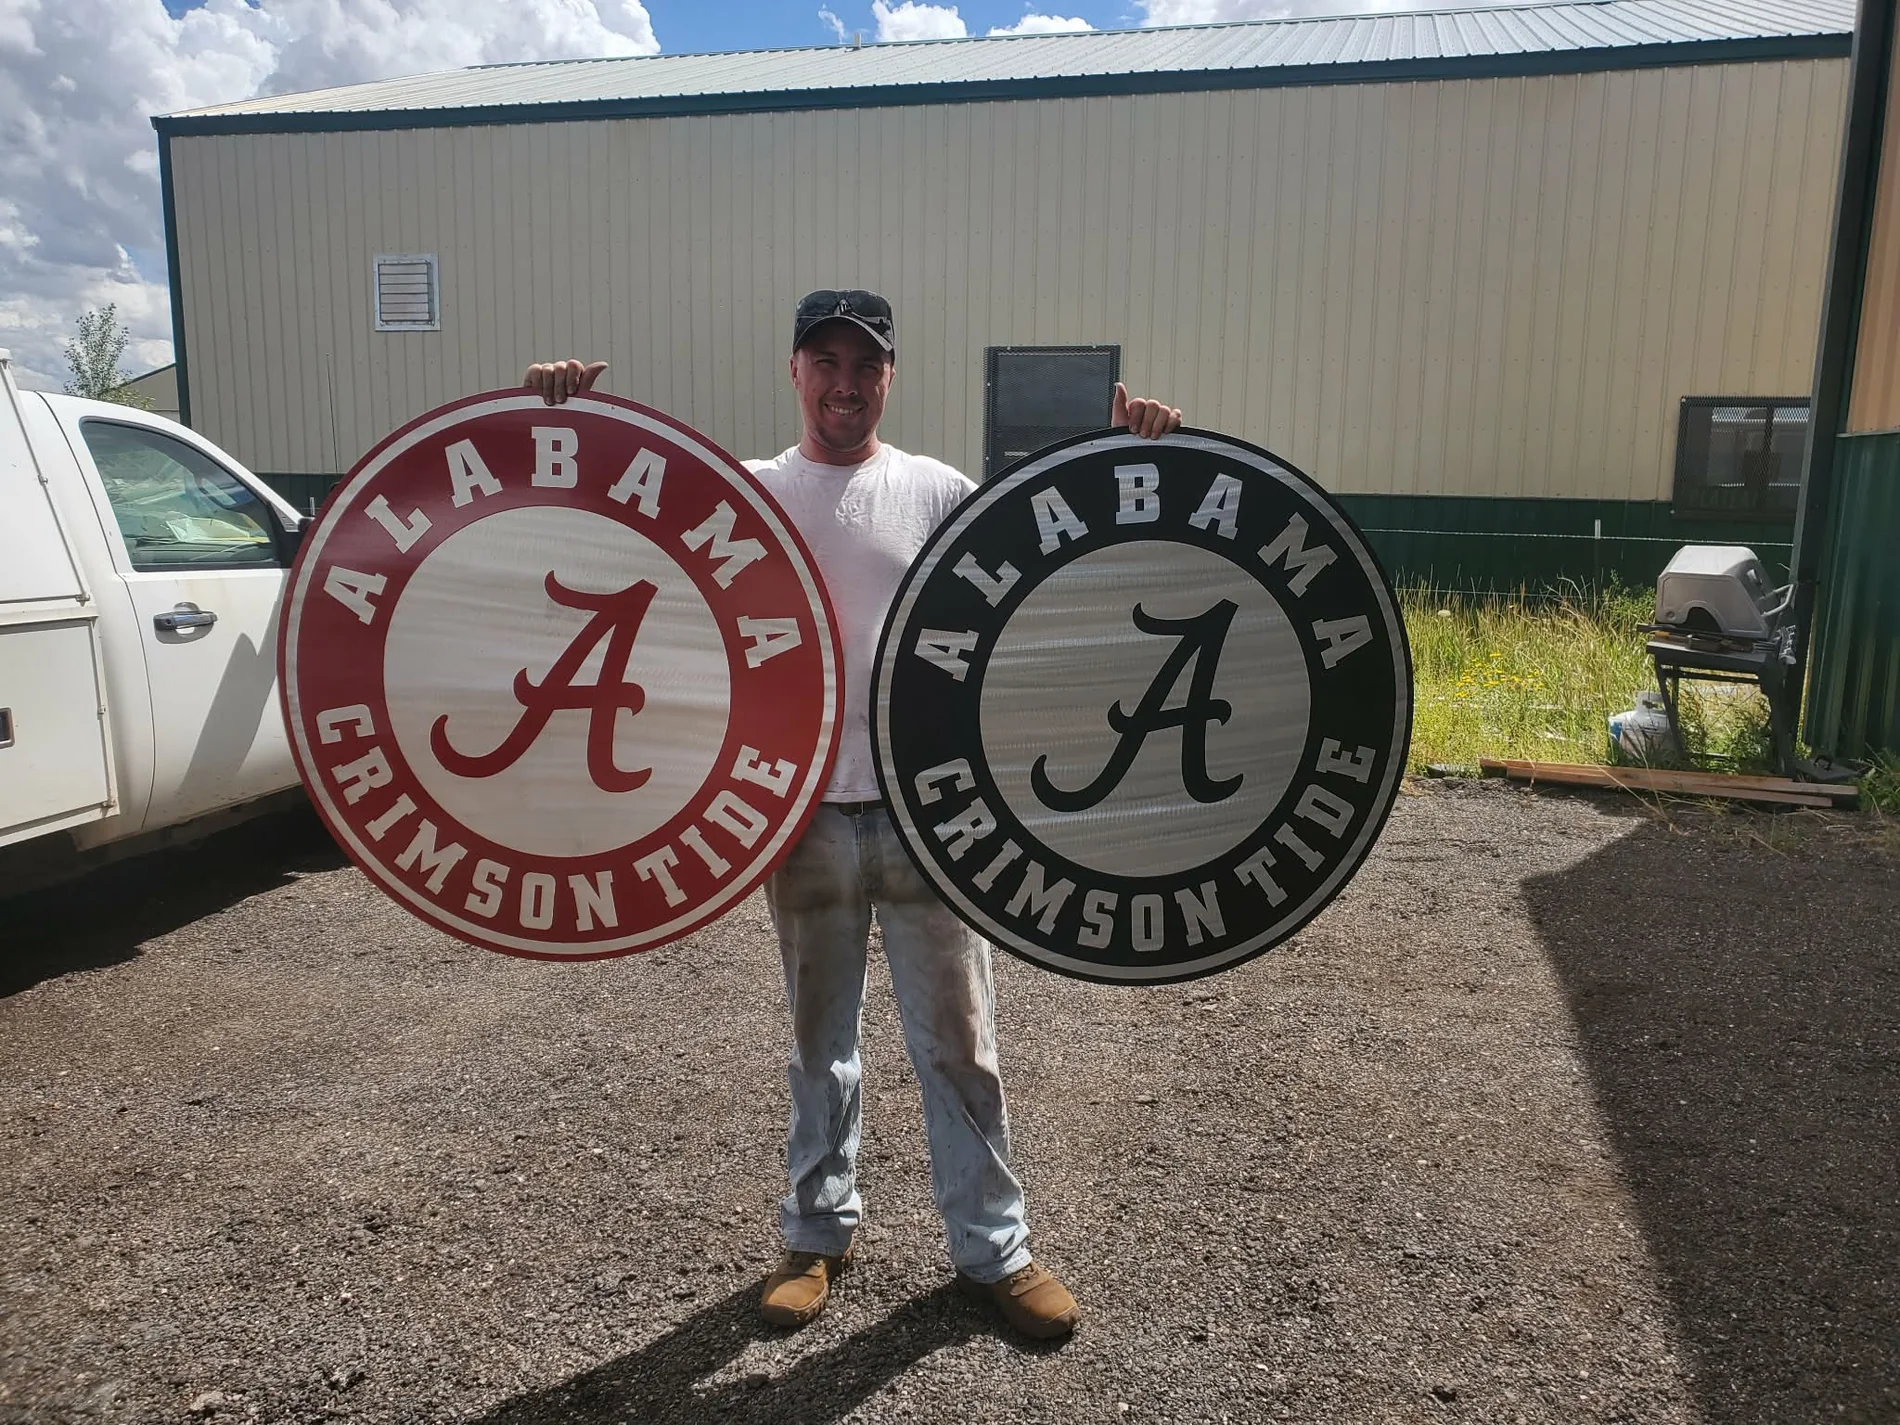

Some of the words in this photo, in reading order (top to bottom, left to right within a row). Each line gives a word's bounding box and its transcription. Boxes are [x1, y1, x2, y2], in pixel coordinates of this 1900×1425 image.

[323, 427, 802, 668] ALABAMA
[914, 463, 1374, 682] ALABAMA
[430, 570, 657, 792] A
[1031, 599, 1244, 813] A
[316, 704, 619, 931] CRIMSON
[633, 745, 797, 908] TIDE
[914, 758, 1227, 952] CRIMSON
[1234, 737, 1376, 908] TIDE
